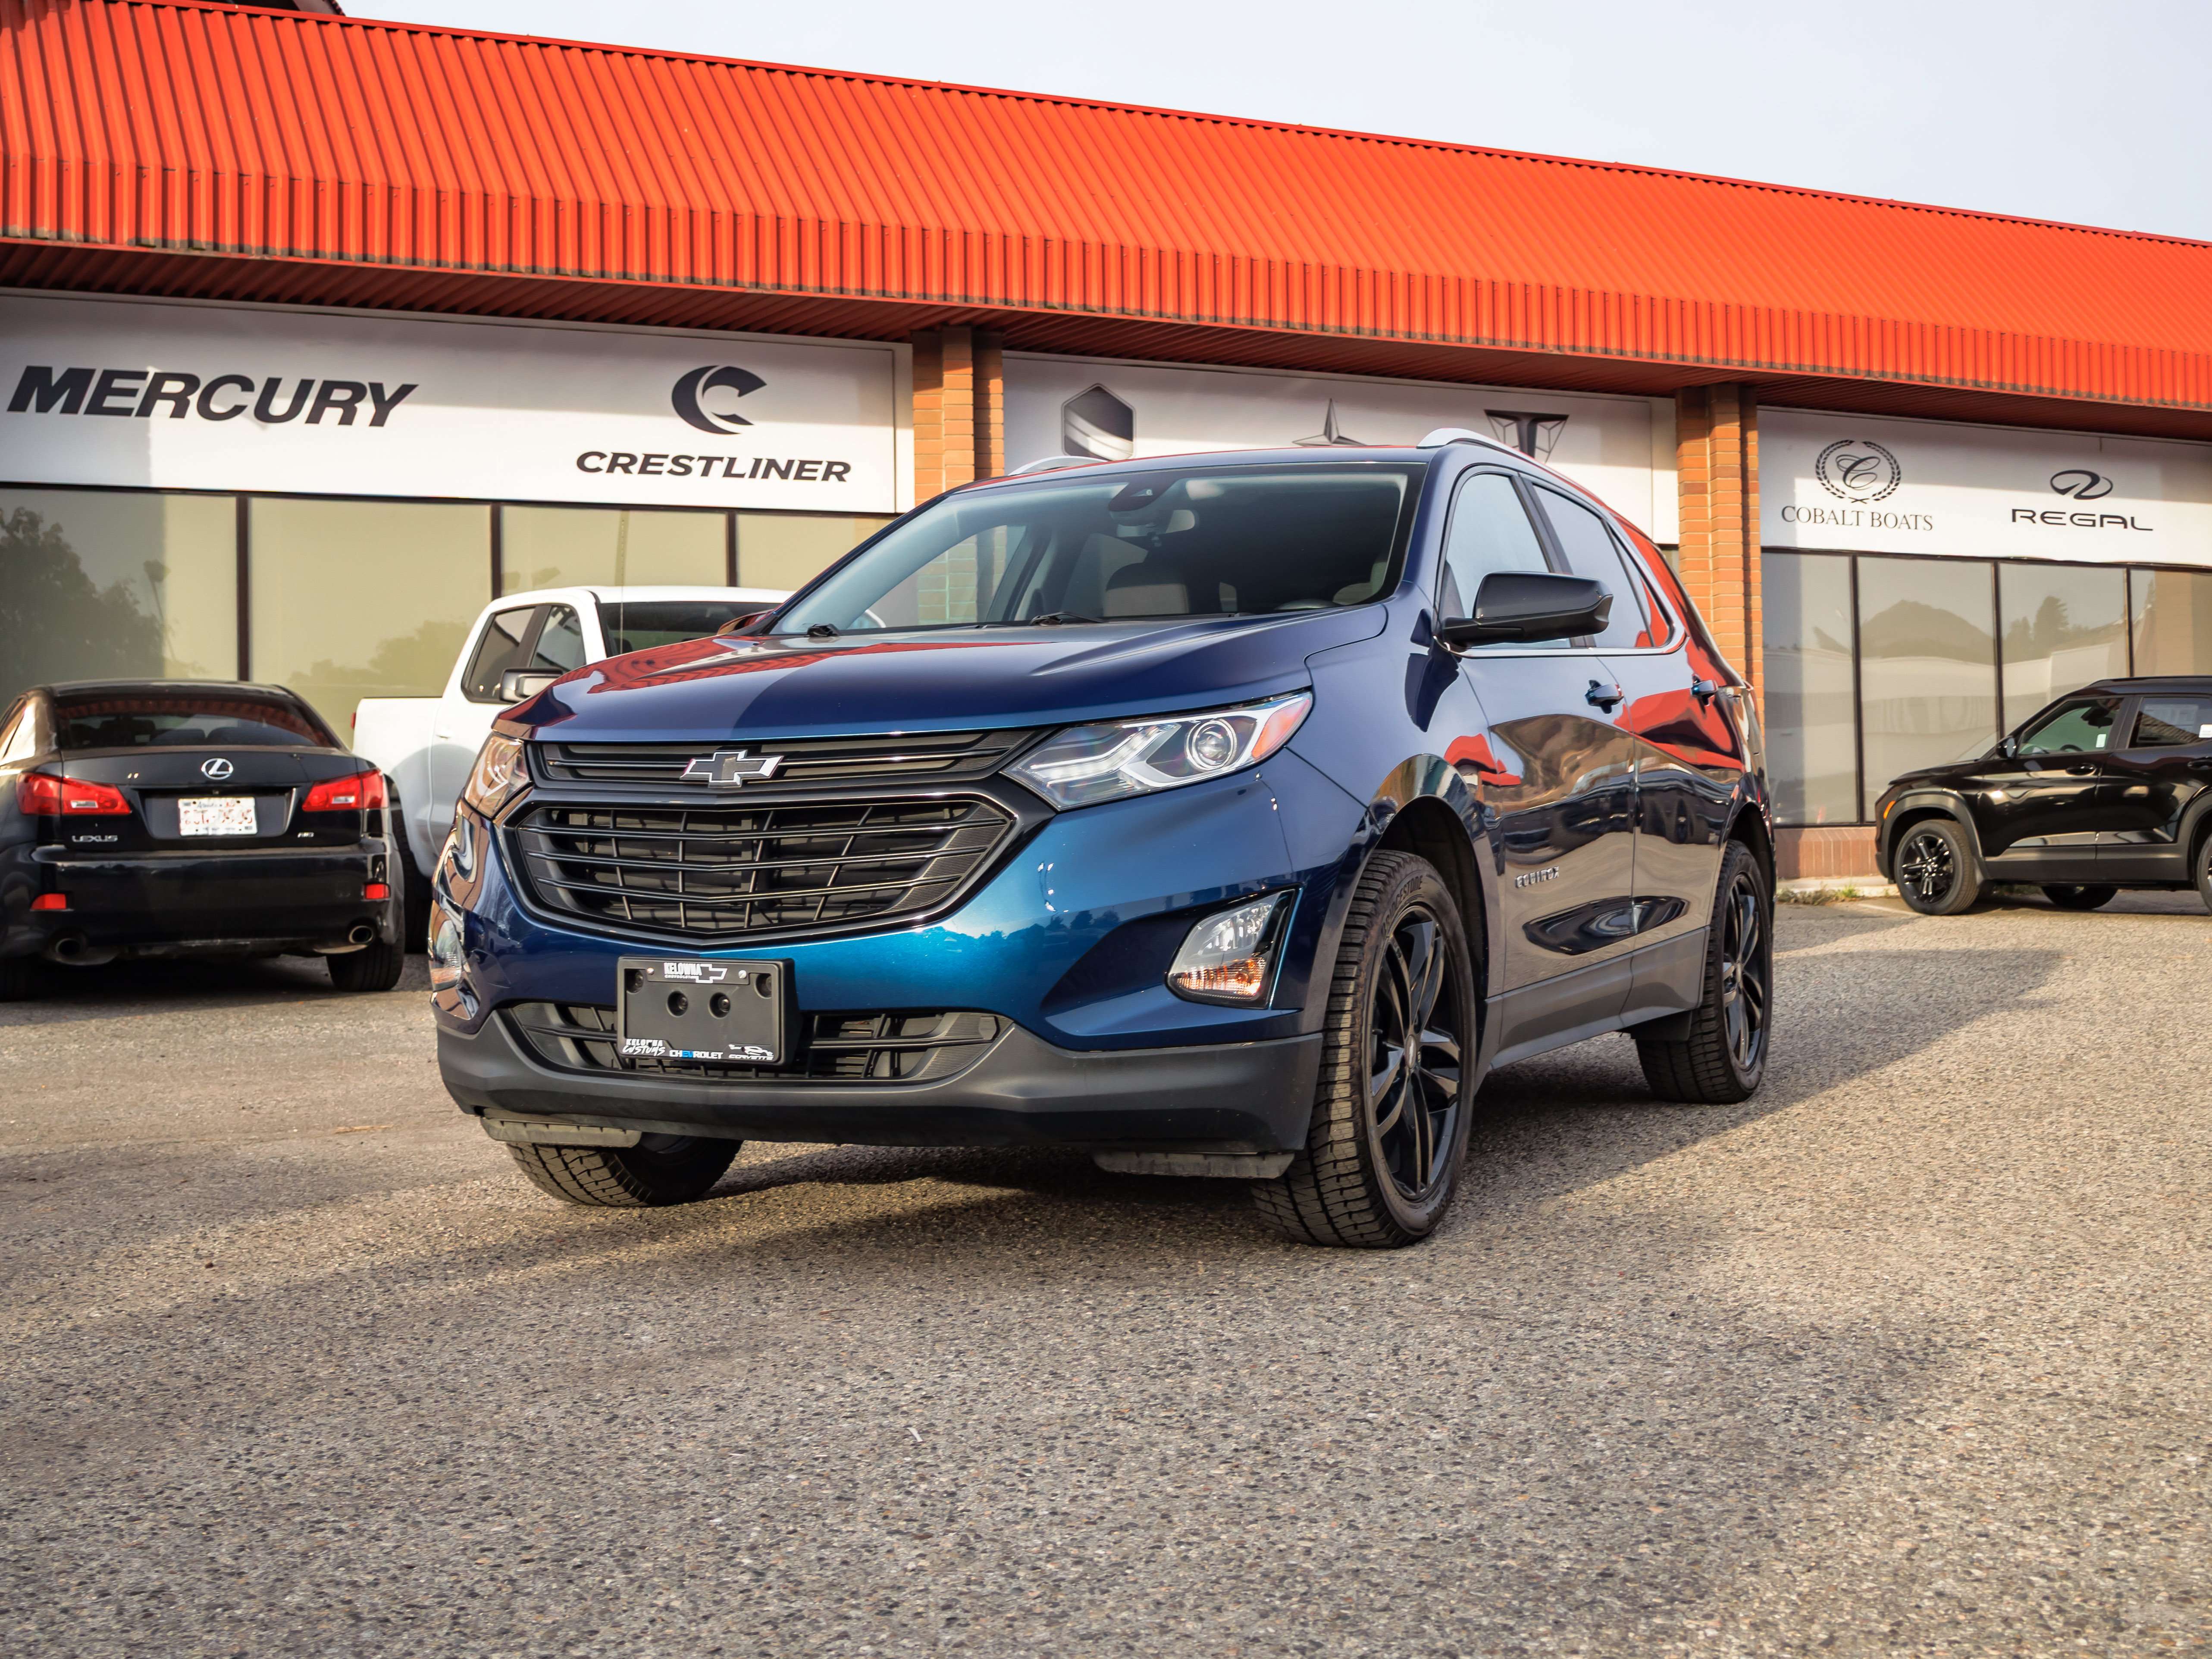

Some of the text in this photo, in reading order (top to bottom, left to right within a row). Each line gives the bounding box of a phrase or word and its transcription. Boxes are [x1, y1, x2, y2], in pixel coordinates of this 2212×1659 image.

[7, 365, 419, 427] MERCURY
[576, 451, 851, 482] CRESTLINER
[1781, 506, 1933, 531] COBALT BOATS
[2012, 509, 2153, 531] REGAL
[1515, 866, 1559, 889] EQUINOX
[669, 1049, 724, 1059] CHEVROLET
